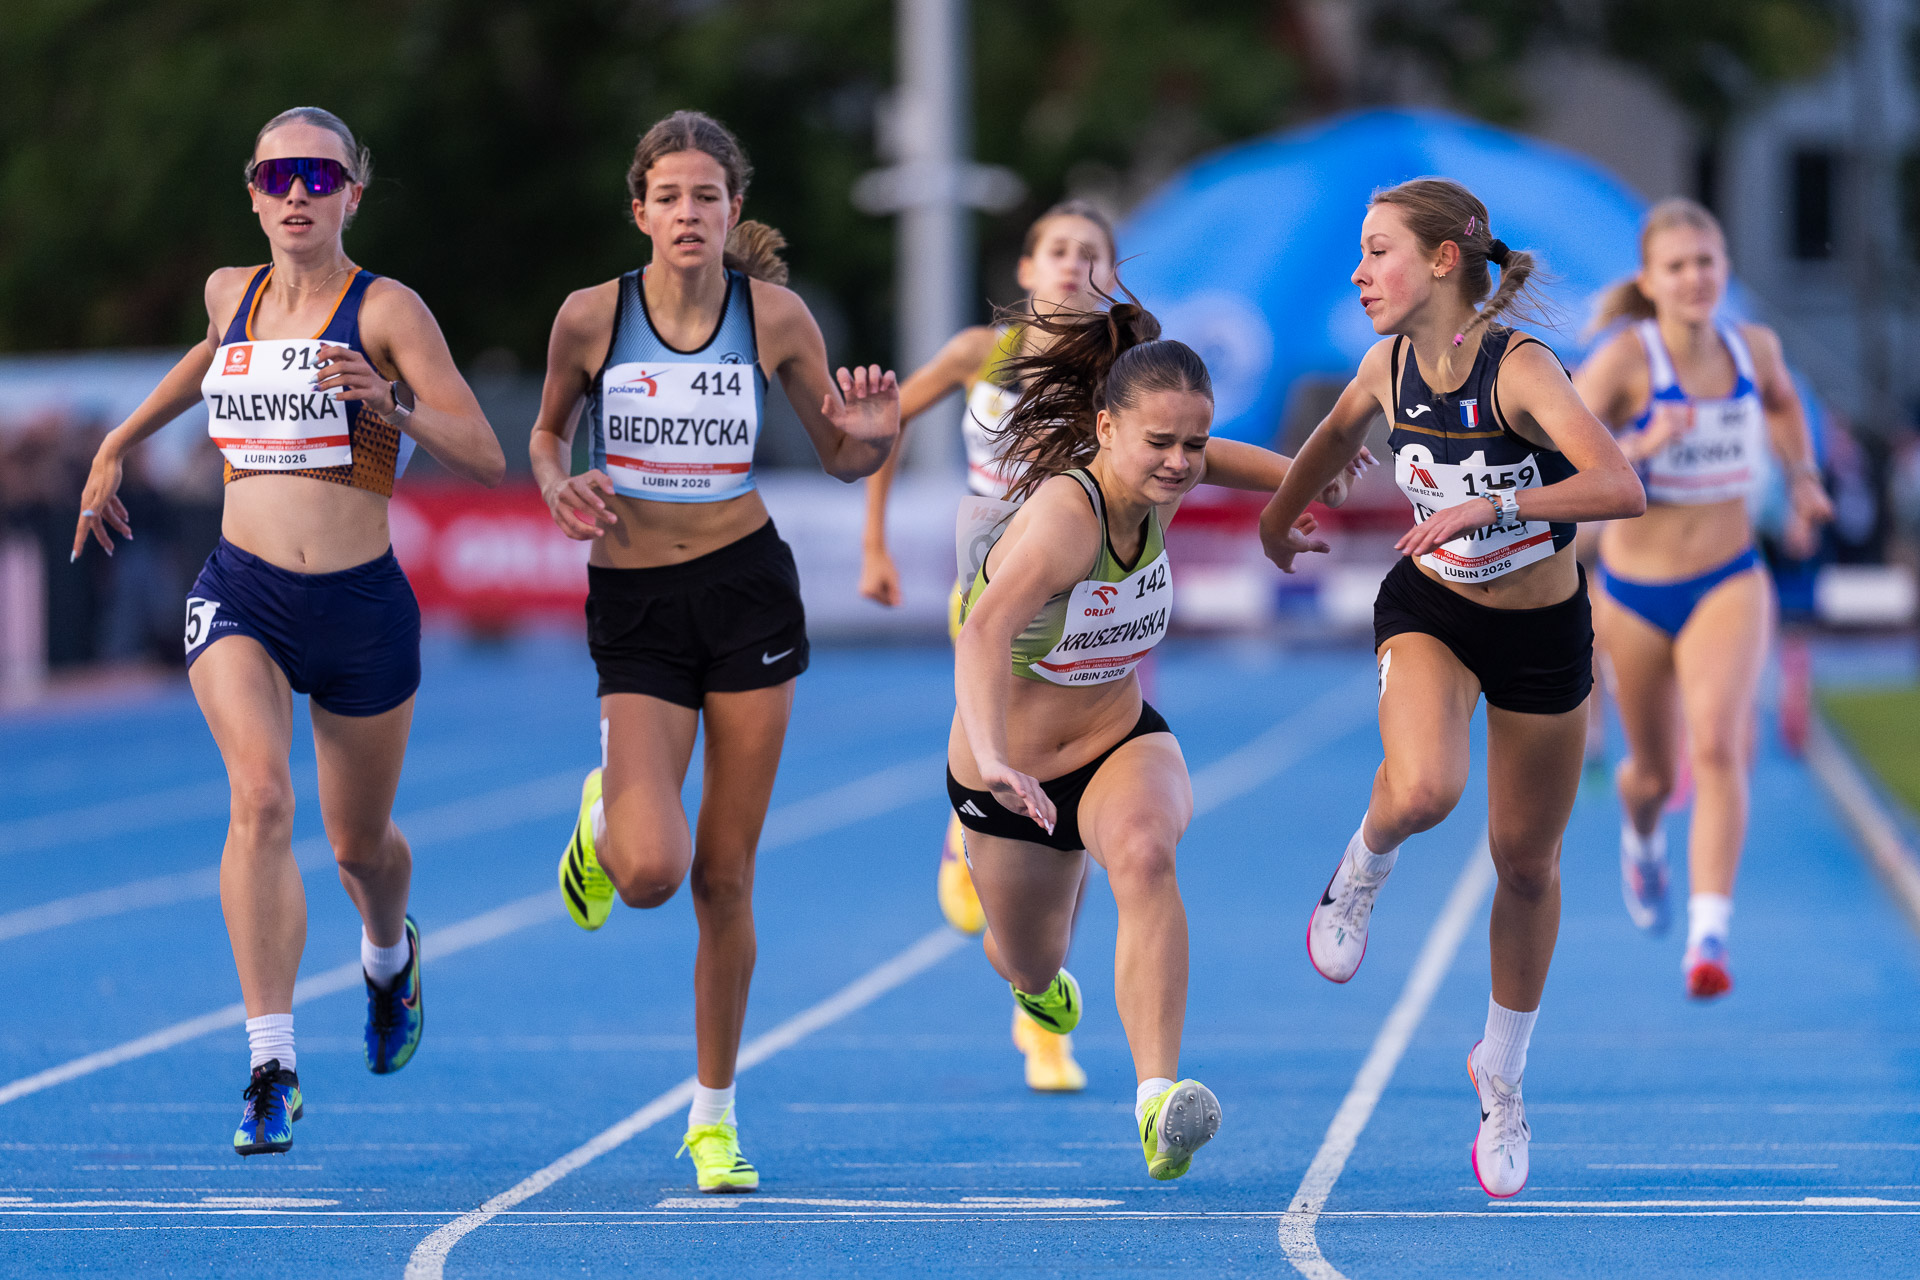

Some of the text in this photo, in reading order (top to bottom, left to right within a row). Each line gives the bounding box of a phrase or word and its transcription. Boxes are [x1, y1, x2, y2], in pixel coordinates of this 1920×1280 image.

[608, 384, 646, 395] polanik
[690, 371, 742, 396] 414
[210, 393, 339, 422] ZALEWSKA
[608, 415, 749, 446] BIEDRZYCKA
[244, 453, 307, 464] LUBIN 2026
[642, 476, 711, 488] LUBIN 2026
[1462, 465, 1535, 497] 1159
[1444, 559, 1512, 578] LUBIN 2026
[1135, 563, 1167, 600] 142
[187, 601, 206, 645] 5
[1084, 606, 1115, 617] ORLEN
[1056, 607, 1166, 652] KRUSZEWSKA
[1069, 667, 1126, 681] LUBIN 2026
